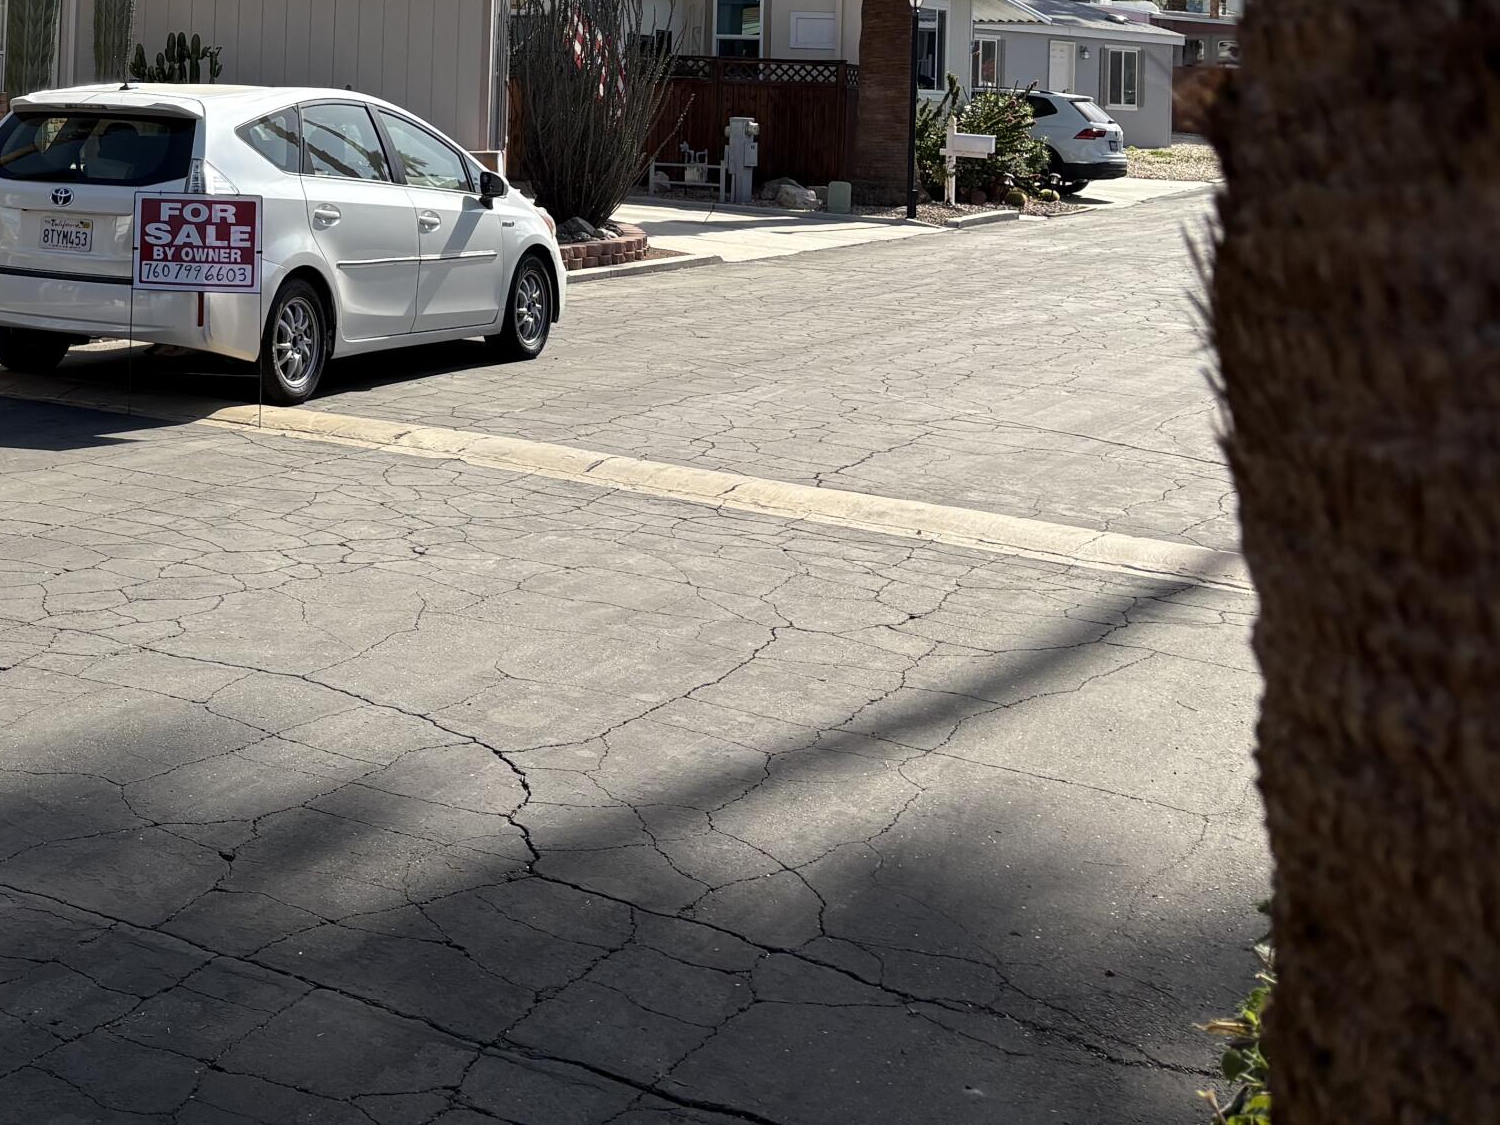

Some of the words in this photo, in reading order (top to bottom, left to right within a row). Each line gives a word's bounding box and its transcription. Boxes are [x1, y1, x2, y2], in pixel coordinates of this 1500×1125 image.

[159, 202, 237, 224] FOR
[42, 228, 88, 247] 8TYM453
[144, 222, 252, 248] SALE
[153, 246, 176, 261] BY
[180, 247, 242, 263] OWNER
[144, 263, 170, 280] 760
